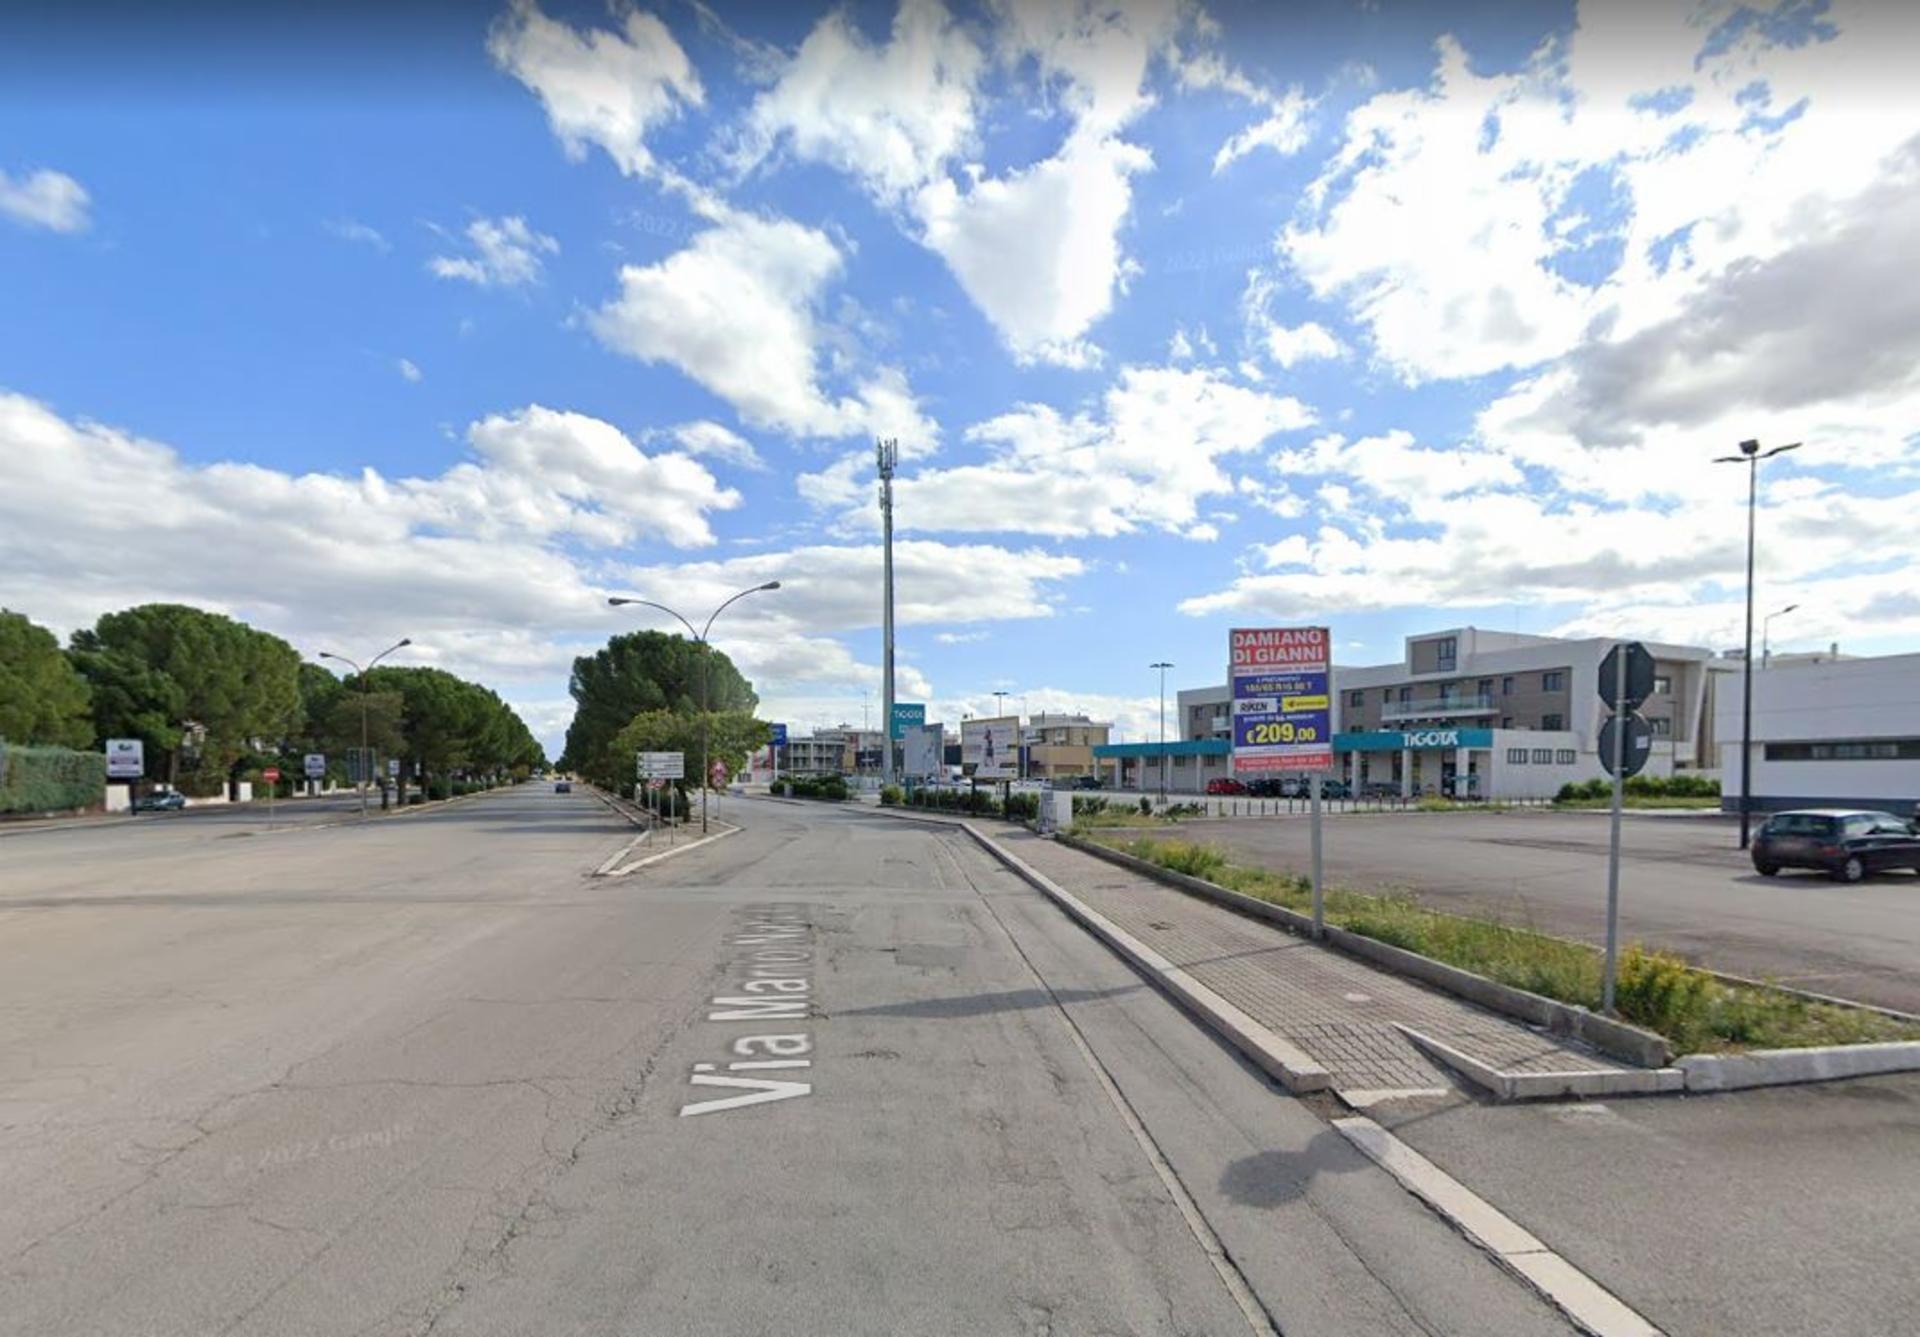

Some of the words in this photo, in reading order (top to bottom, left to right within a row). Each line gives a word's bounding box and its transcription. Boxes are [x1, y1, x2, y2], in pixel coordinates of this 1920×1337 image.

[1234, 631, 1321, 647] DAMIANO
[1234, 649, 1251, 663] DI
[1256, 646, 1323, 662] GIANNI
